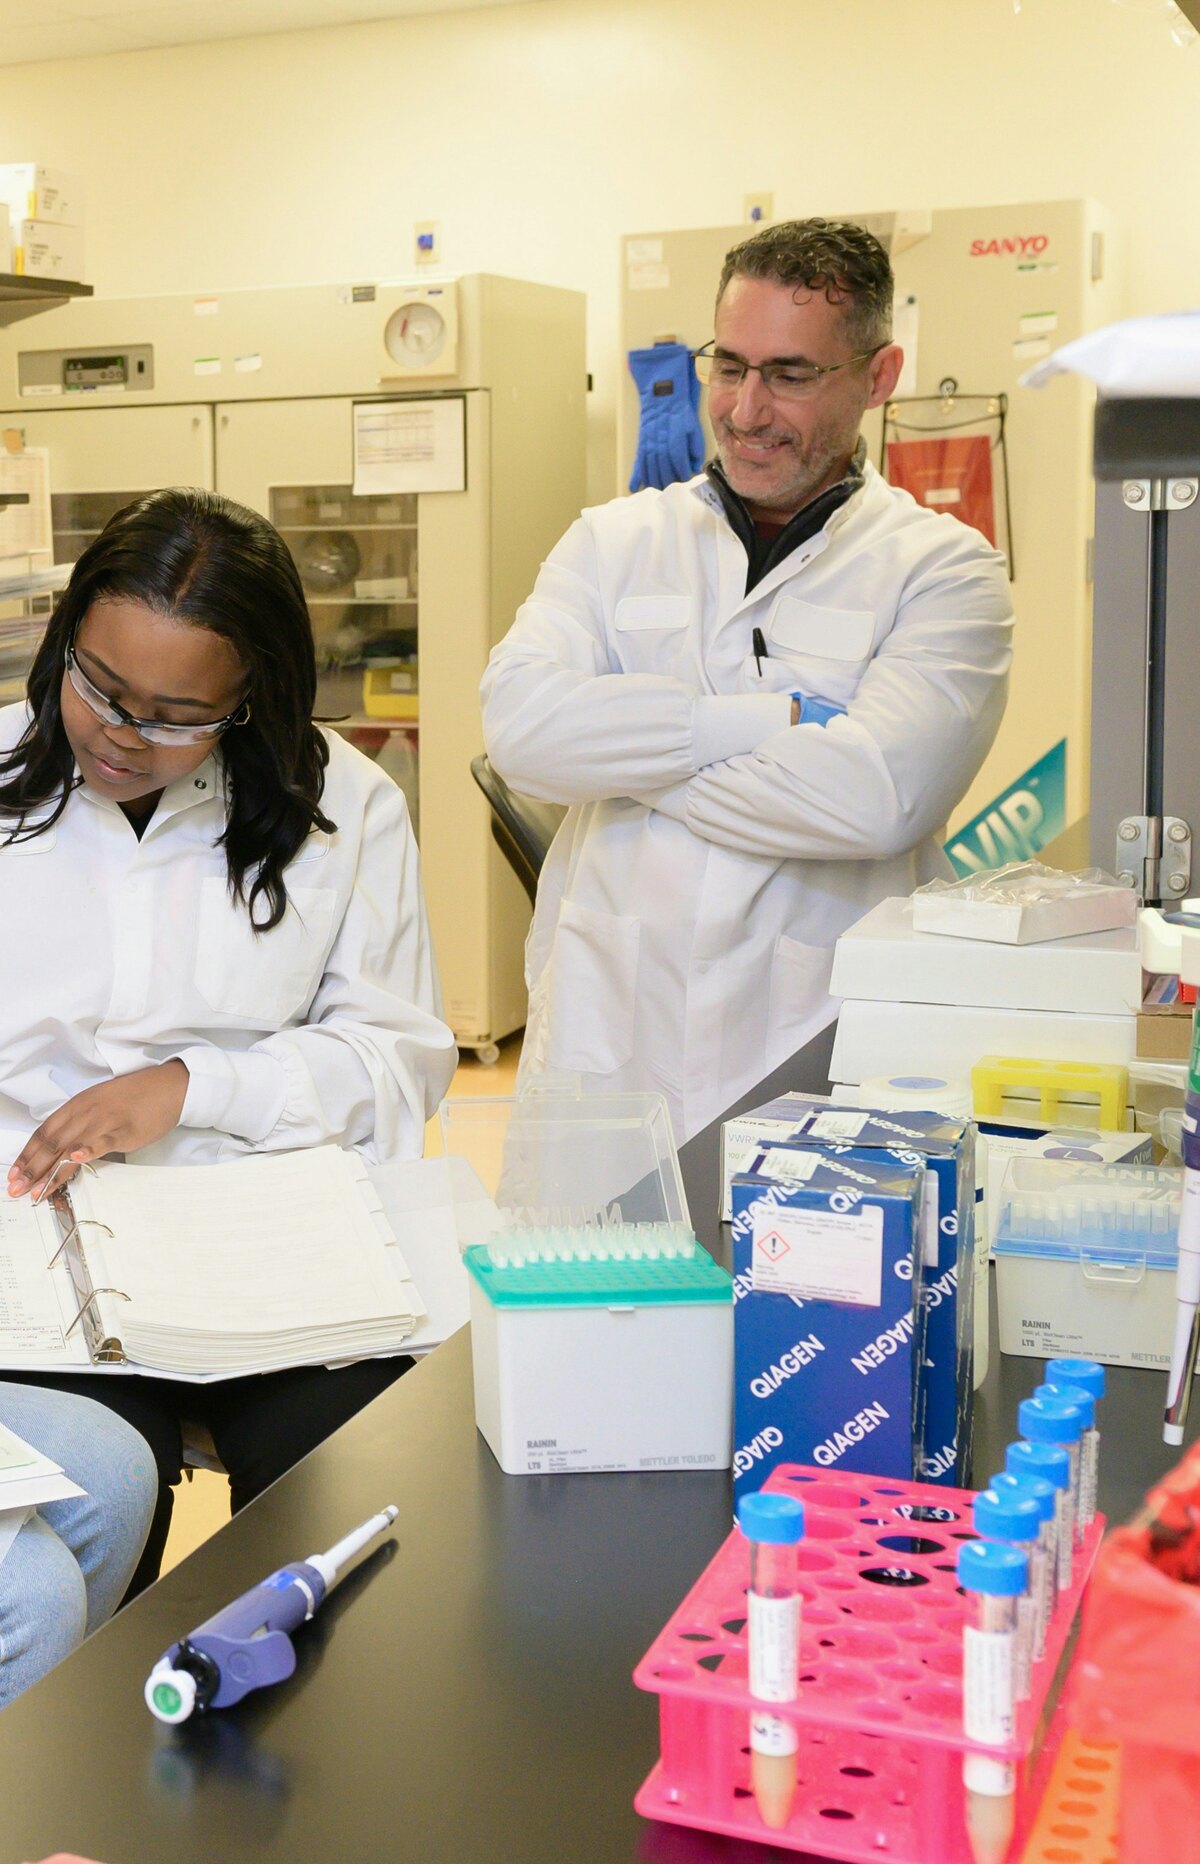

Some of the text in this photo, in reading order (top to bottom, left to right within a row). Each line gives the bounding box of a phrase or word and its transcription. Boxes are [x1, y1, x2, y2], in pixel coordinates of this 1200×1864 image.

[970, 235, 1048, 257] SANYO
[951, 789, 1045, 872] VIP
[1022, 1320, 1051, 1330] RAININ
[1022, 1339, 1035, 1347] LTS
[1131, 1352, 1171, 1364] METTLER
[750, 1333, 826, 1399] QIAGEN
[813, 1401, 890, 1466] QIAGEN
[527, 1440, 557, 1449] RAININ
[528, 1462, 541, 1470] LTS
[639, 1455, 679, 1467] METTLER
[682, 1454, 716, 1464] TOLEDO
